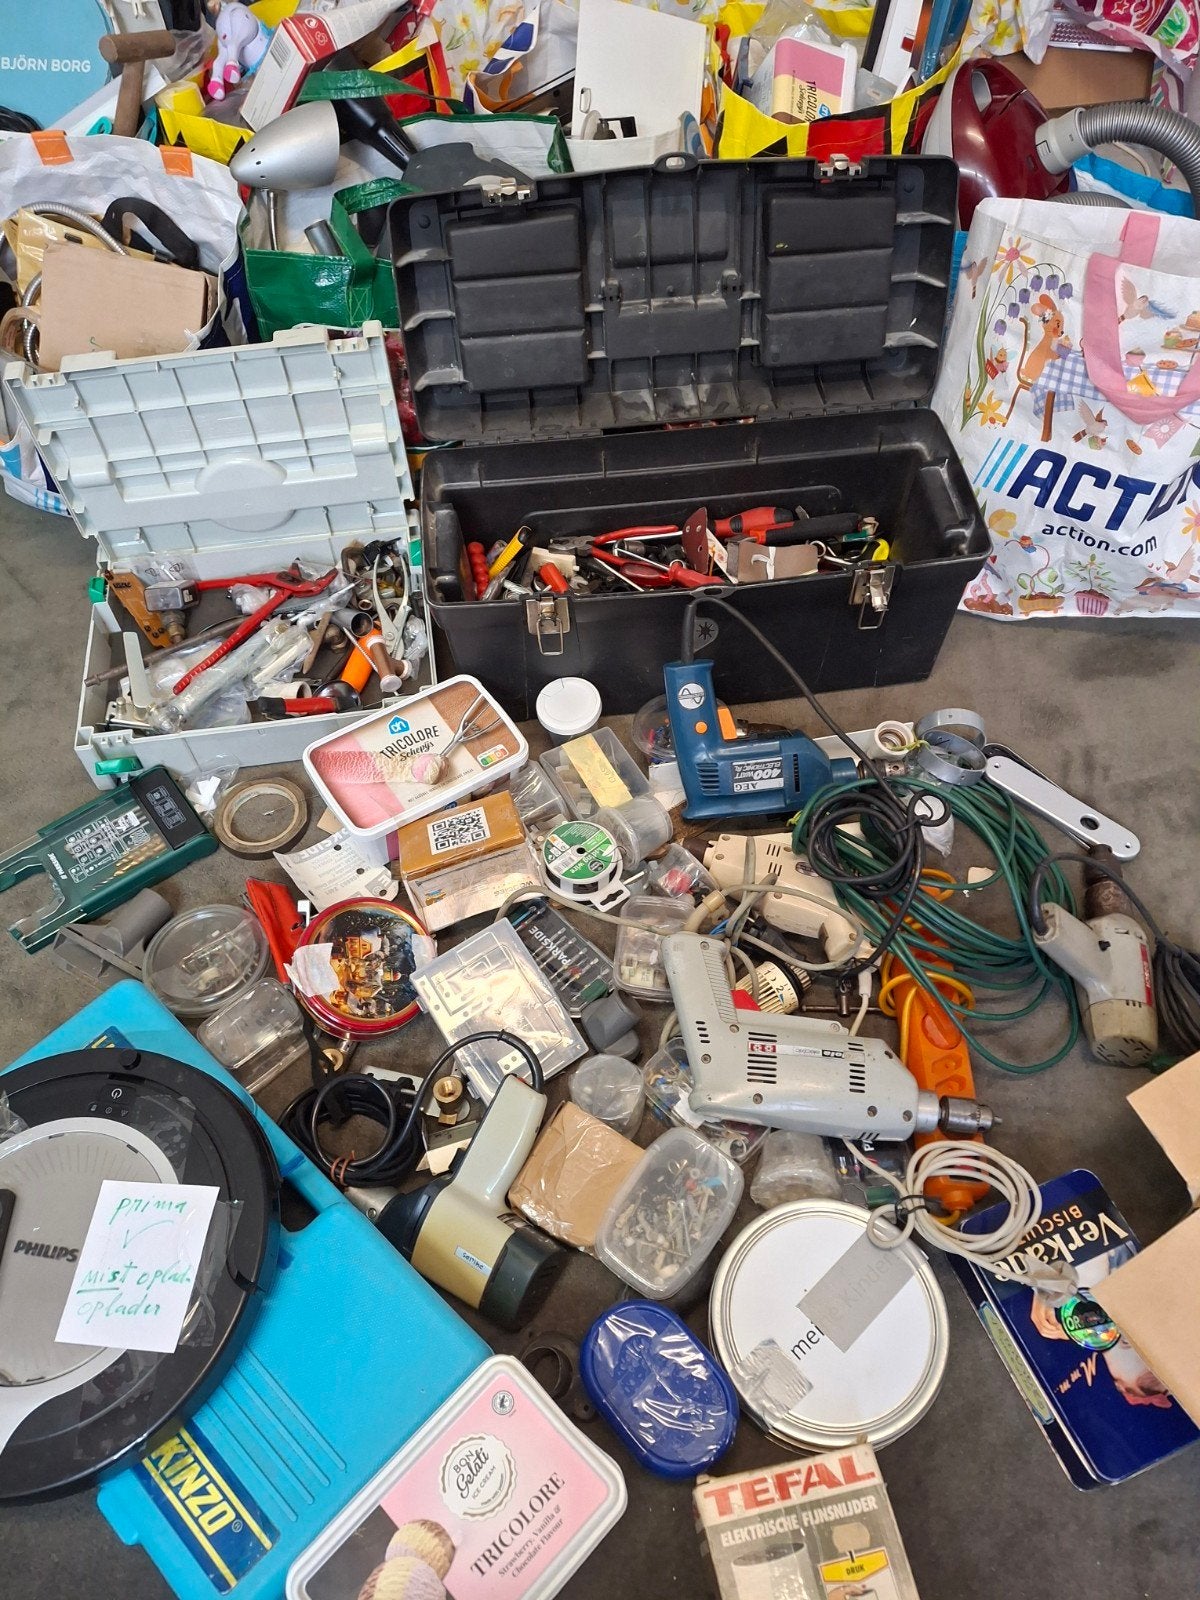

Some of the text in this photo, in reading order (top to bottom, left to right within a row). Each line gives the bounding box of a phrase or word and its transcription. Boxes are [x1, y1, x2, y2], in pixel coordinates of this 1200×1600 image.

[1, 54, 91, 73] BJÖRN BORG
[804, 80, 818, 122] TRICOLOR
[1042, 523, 1158, 557] action.com
[379, 725, 441, 760] TRICOLORE
[735, 782, 758, 791] AEG
[753, 768, 782, 780] 400
[528, 925, 571, 965] PARKSIDE
[13, 1240, 80, 1263] PHILIPS
[453, 1449, 475, 1474] BON
[456, 1447, 489, 1499] Gelati
[150, 1436, 237, 1536] KINZO
[472, 1465, 496, 1500] ICE CREAM
[703, 1455, 876, 1518] TEFAL
[470, 1471, 566, 1578] TRICOLORE
[532, 1513, 555, 1538] Vanilla
[720, 1514, 801, 1548] ELEKTRISCHE
[511, 1518, 564, 1578] Chocolate Flavour
[846, 1563, 866, 1577] DRUK
